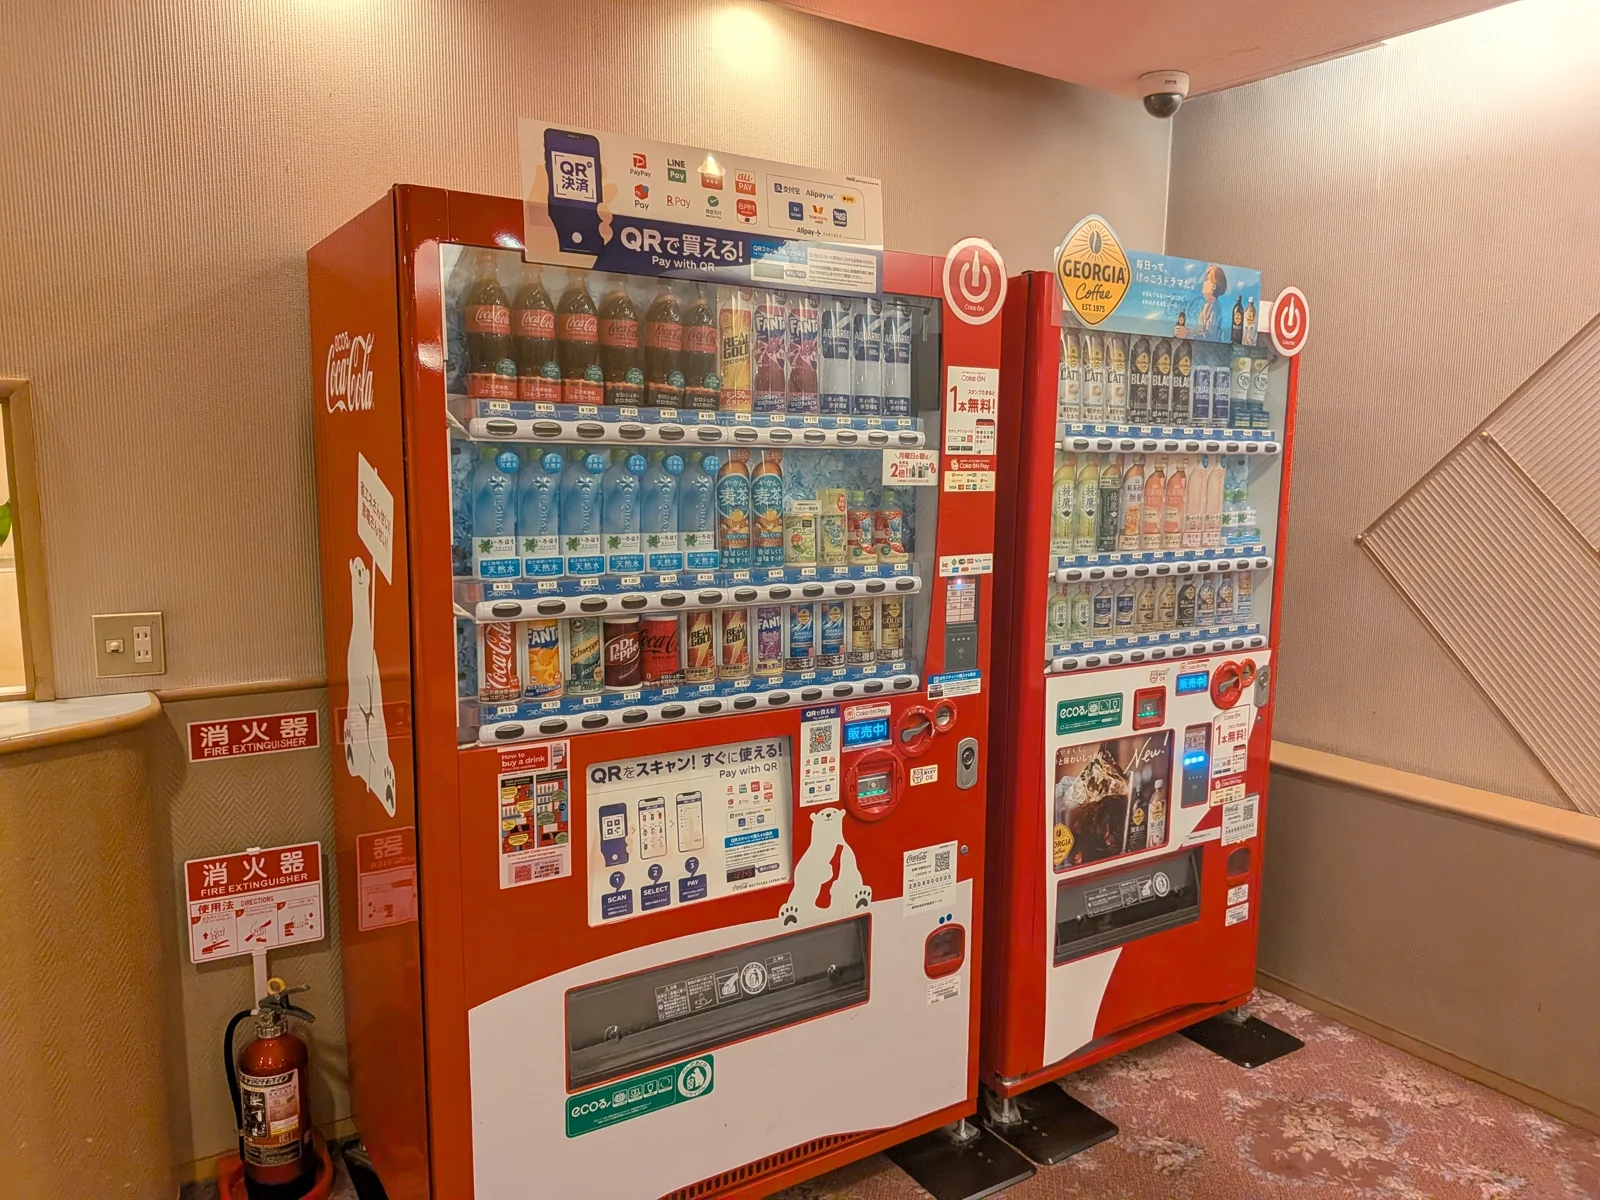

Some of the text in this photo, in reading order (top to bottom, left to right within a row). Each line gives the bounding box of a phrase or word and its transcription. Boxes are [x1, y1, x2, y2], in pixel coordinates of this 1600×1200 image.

[560, 161, 588, 178] QR
[667, 158, 686, 169] LINE
[629, 168, 652, 178] PayPay
[669, 170, 685, 181] Pay
[561, 176, 588, 193] 決済
[738, 182, 753, 192] PAY
[634, 199, 650, 211] Pay
[675, 197, 691, 209] Pay
[796, 226, 815, 237] Alipay
[651, 255, 715, 272] Pay with QR
[1136, 258, 1168, 274] 毎日って、
[1062, 259, 1126, 285] GEORGIA
[1135, 273, 1196, 291] けっこうドラマだ。
[1075, 282, 1113, 302] Coffee
[1081, 303, 1106, 313] EST. 1975
[325, 332, 375, 414] Coca-Cola
[960, 373, 986, 383] Coke ON
[949, 385, 996, 415] 1本無料!
[980, 462, 990, 470] Pay
[719, 487, 749, 506] 麦茶
[754, 487, 782, 506] 麦茶
[575, 562, 600, 571] 天然水
[616, 560, 640, 569] 天然水
[656, 559, 679, 567] 天然水
[693, 557, 715, 565] 天然水
[488, 565, 515, 575] 天然水
[533, 563, 559, 573] 天然水
[691, 626, 711, 639] REAL
[726, 623, 746, 637] REAL
[619, 637, 635, 650] Dr
[485, 621, 512, 690] Coca-Cola
[1179, 676, 1204, 691] 販売中
[855, 709, 870, 717] Coke
[877, 707, 888, 715] Pay
[200, 716, 309, 748] 消火器
[847, 723, 884, 741] 販売中
[1215, 724, 1247, 746] 1本無料!
[204, 736, 307, 758] FIRE EXTINGUISHER
[1122, 731, 1170, 775] New!
[525, 755, 546, 764] drink
[590, 742, 783, 784] QRをスキャン! すぐに使える!
[718, 762, 778, 779] Pay with QR
[905, 851, 928, 864] Coca-Cola
[202, 850, 305, 887] 消火器
[200, 872, 309, 898] FIRE EXTINGUISHER
[686, 879, 700, 887] PAY
[643, 885, 669, 896] SELECT
[240, 895, 275, 907] DIRECTIONS
[607, 894, 627, 904] SCAN
[197, 900, 235, 915] 使用法
[684, 1085, 706, 1097] リサイクル
